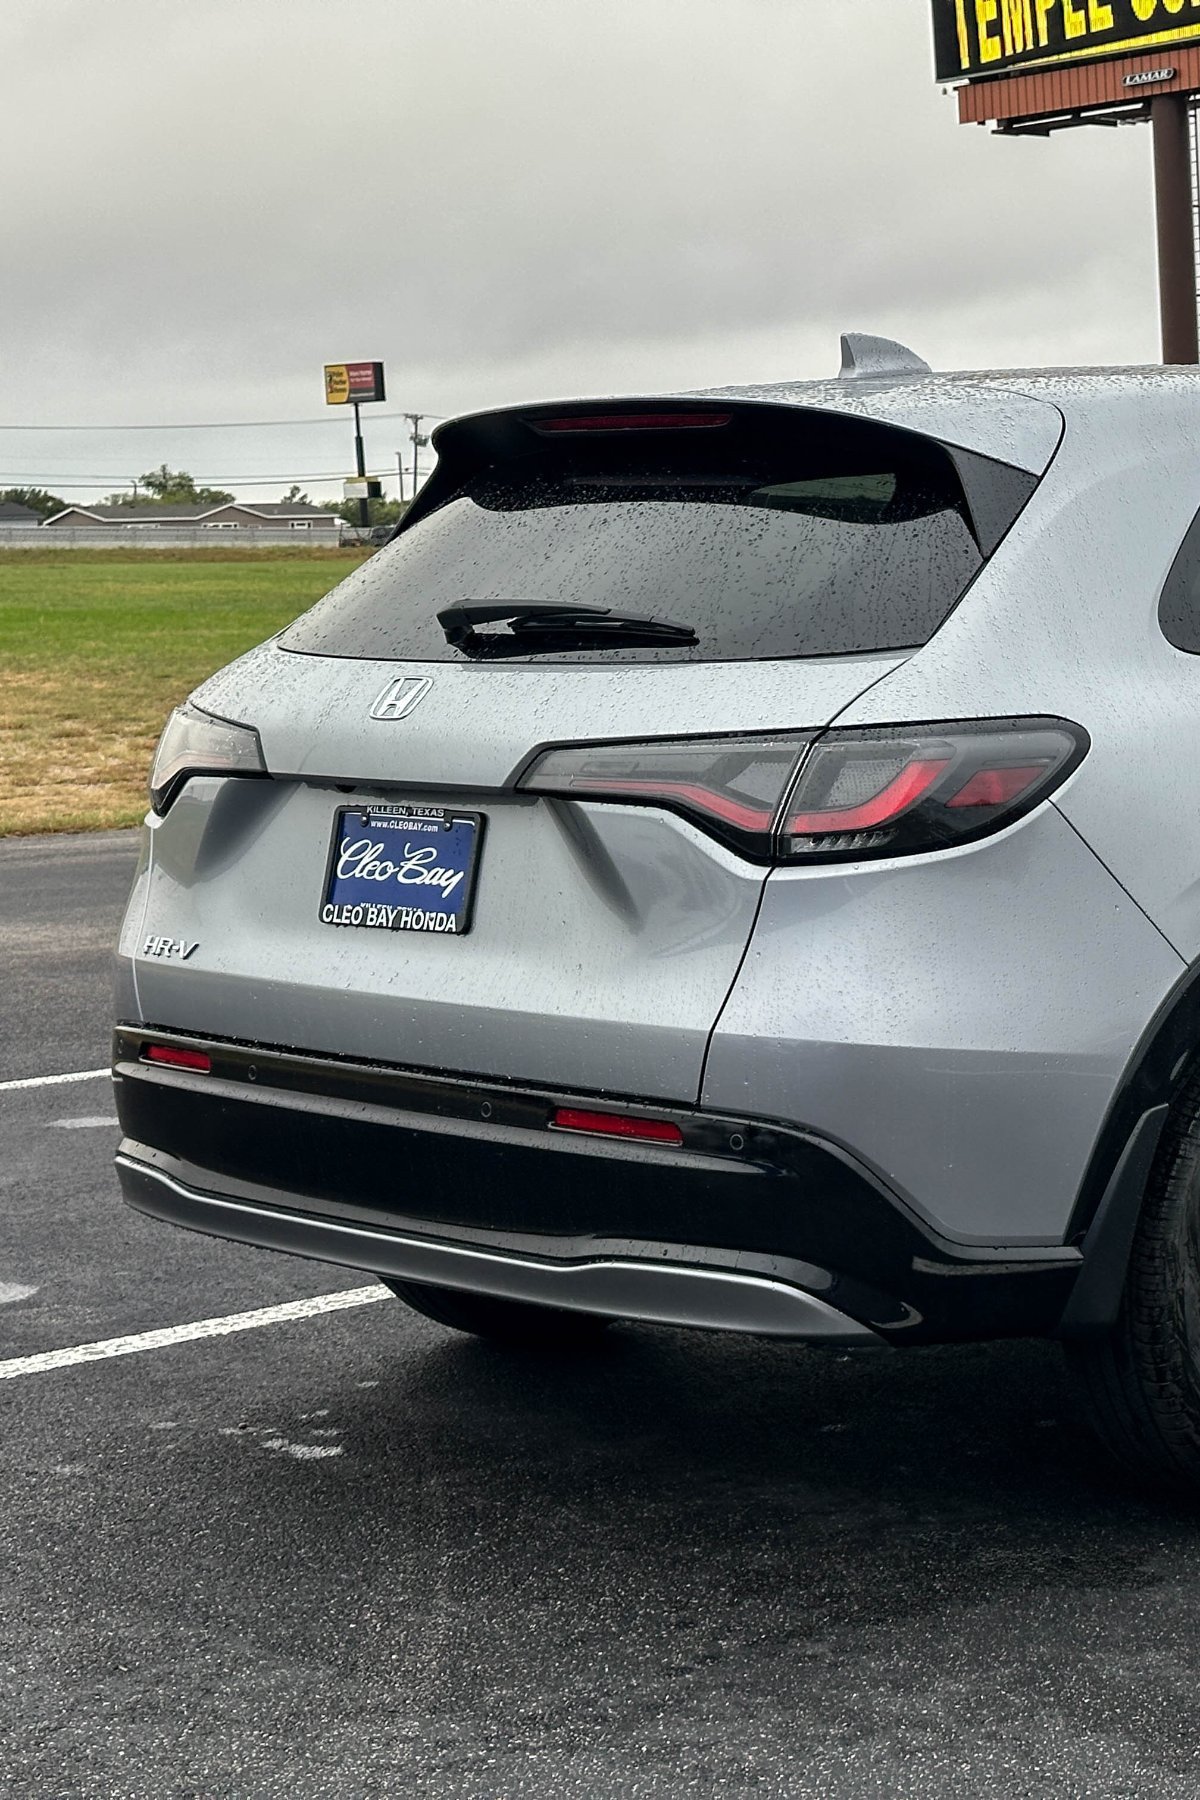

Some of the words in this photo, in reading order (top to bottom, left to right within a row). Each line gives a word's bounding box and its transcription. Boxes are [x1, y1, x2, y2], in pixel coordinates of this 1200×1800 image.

[1125, 69, 1170, 85] LAMAR
[366, 806, 409, 816] KILLEEN,
[411, 807, 445, 817] TEXAS
[370, 820, 439, 832] www.CLEOBAY.com
[336, 836, 399, 881] Cleo
[397, 842, 465, 899] Bay
[322, 903, 364, 926] CLEO
[366, 907, 399, 928] BAY
[400, 909, 457, 932] HONDA
[143, 935, 200, 960] HR-V
